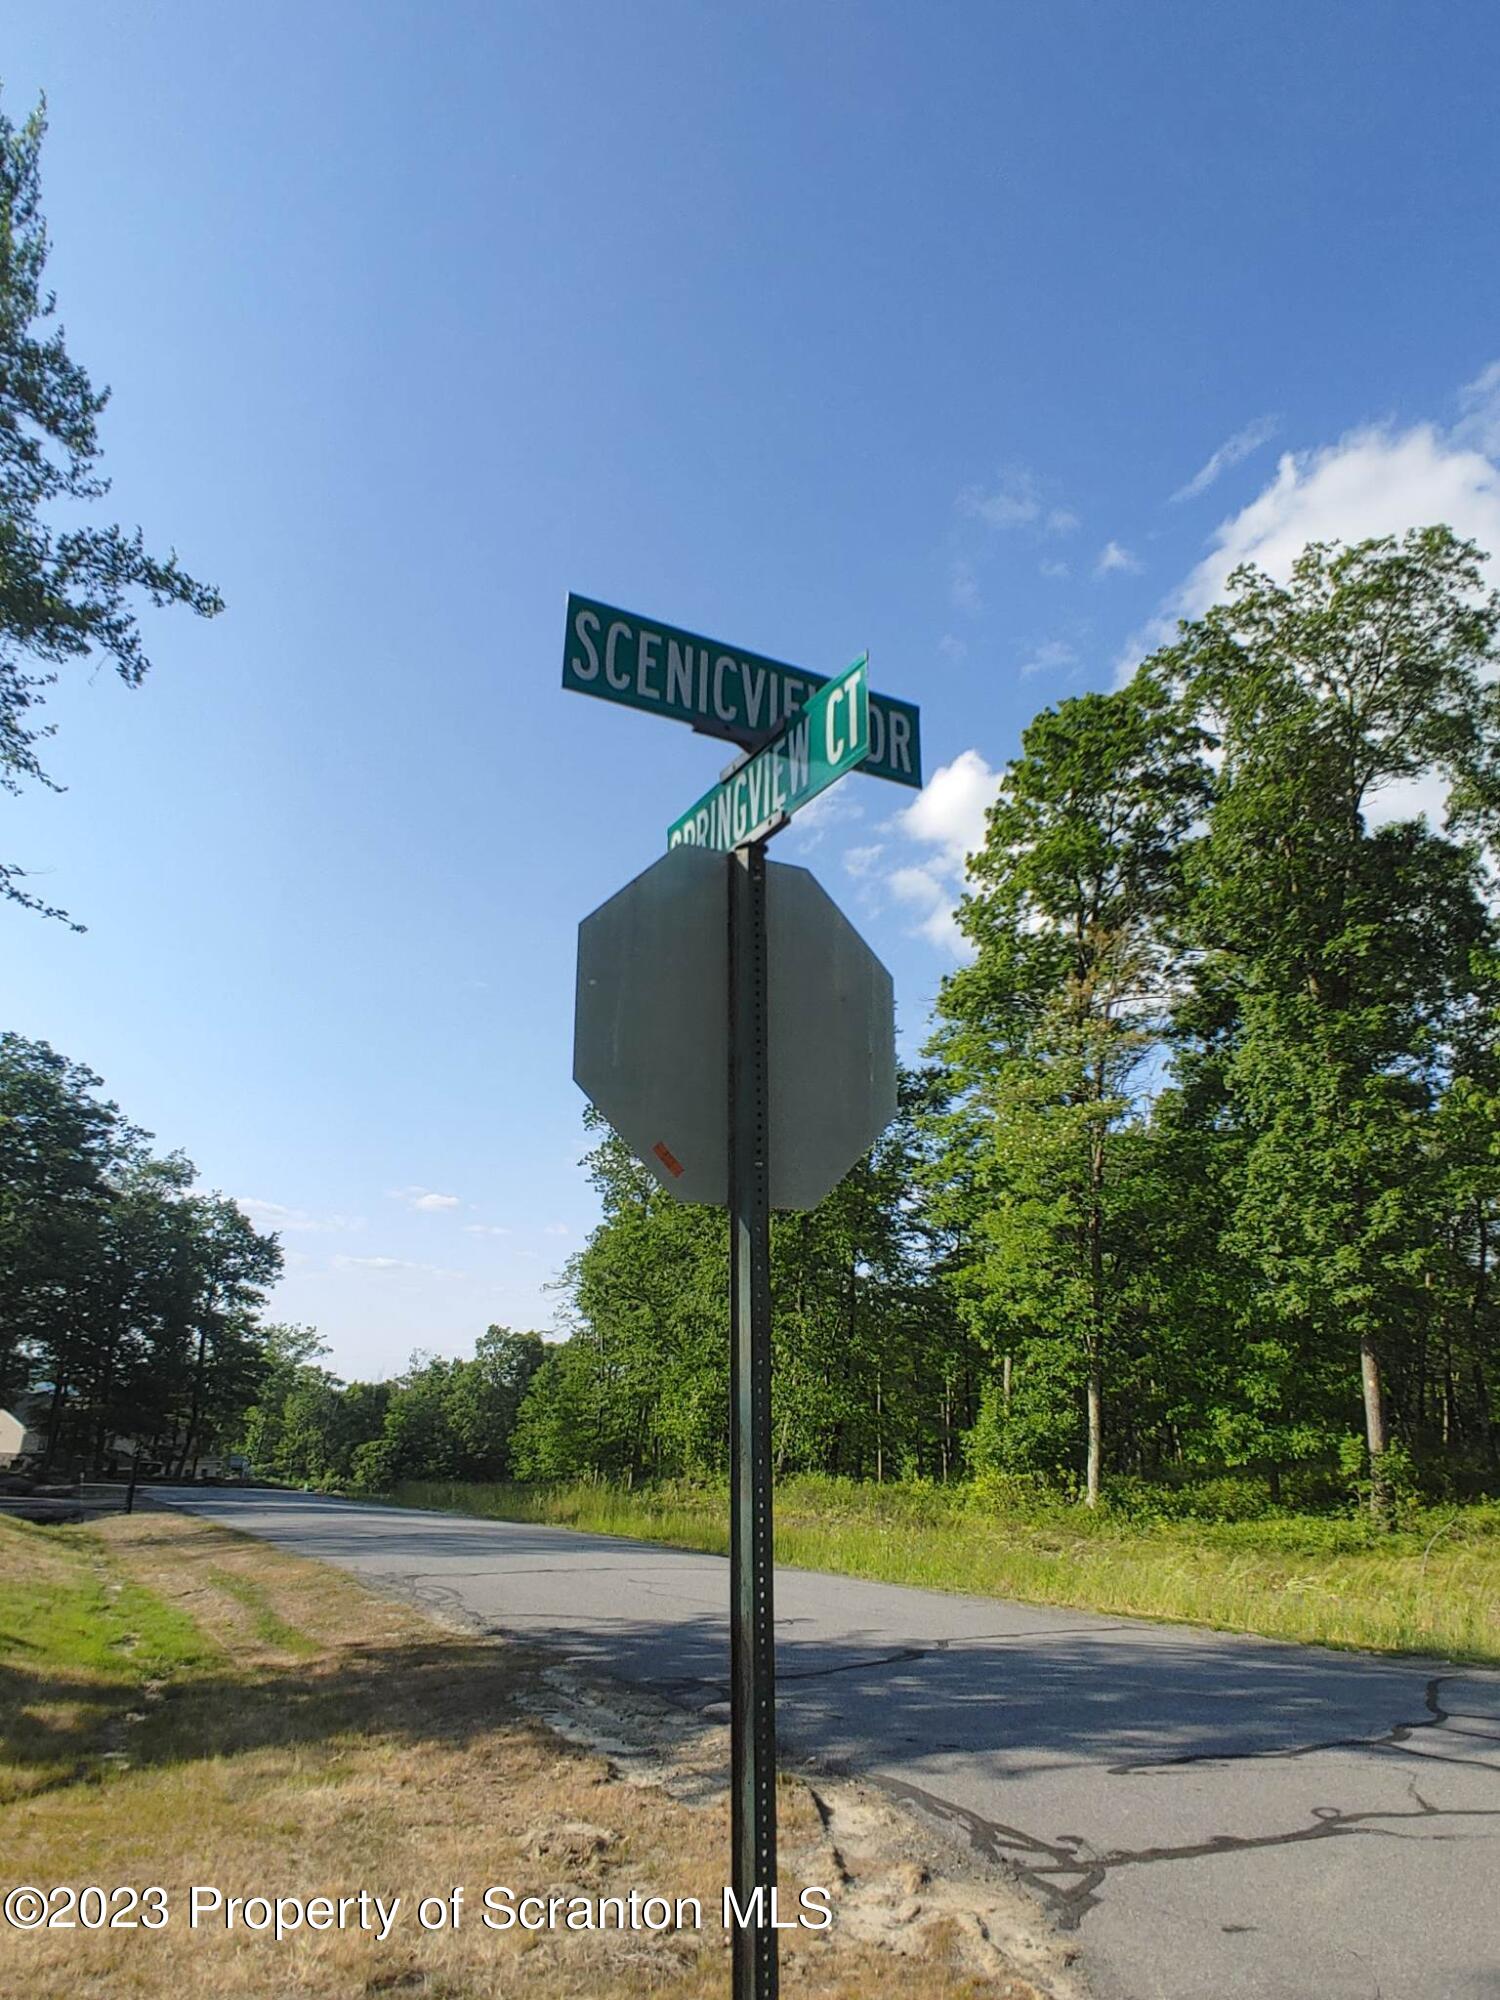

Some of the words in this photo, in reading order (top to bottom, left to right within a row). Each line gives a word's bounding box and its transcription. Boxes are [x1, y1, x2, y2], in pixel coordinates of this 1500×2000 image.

[571, 609, 818, 728] SCENICVIE
[867, 703, 912, 774] DR
[826, 670, 861, 765] CT
